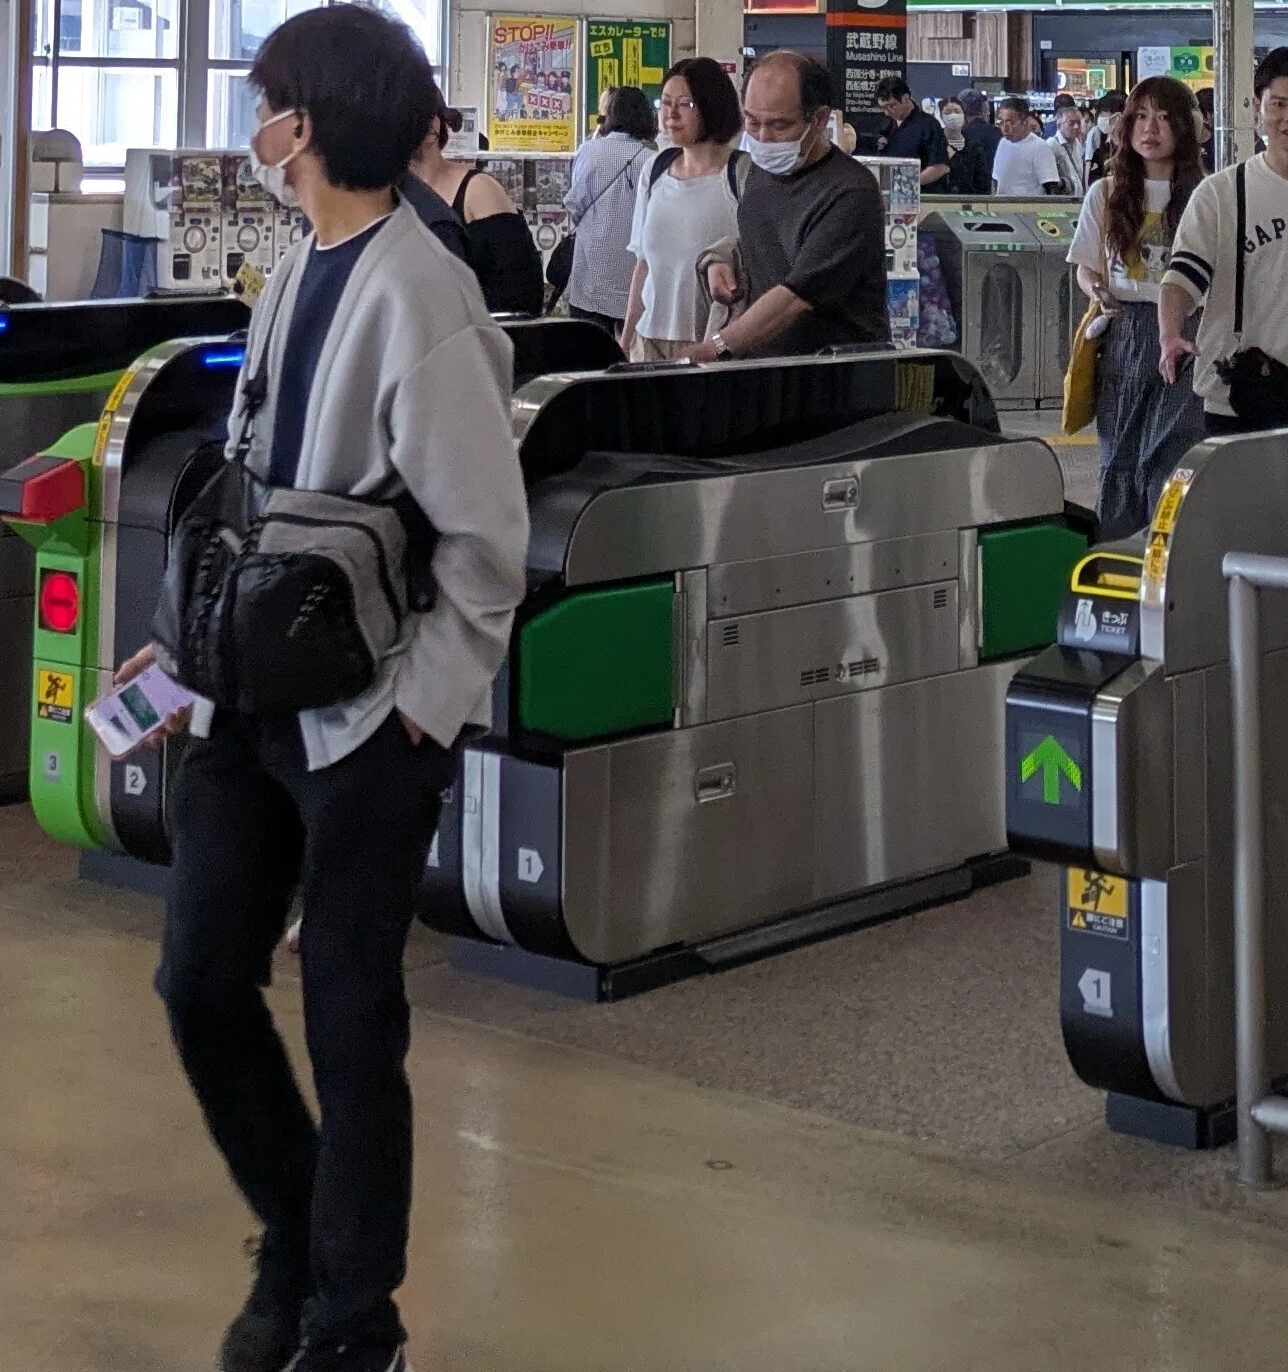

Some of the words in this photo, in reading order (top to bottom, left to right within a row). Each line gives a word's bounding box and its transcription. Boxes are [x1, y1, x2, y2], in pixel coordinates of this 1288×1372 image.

[589, 24, 667, 38] エスカレーターでは
[845, 32, 898, 51] 武蔵野線
[128, 771, 140, 788] 2
[525, 855, 533, 875] 1
[1092, 978, 1102, 999] 1
